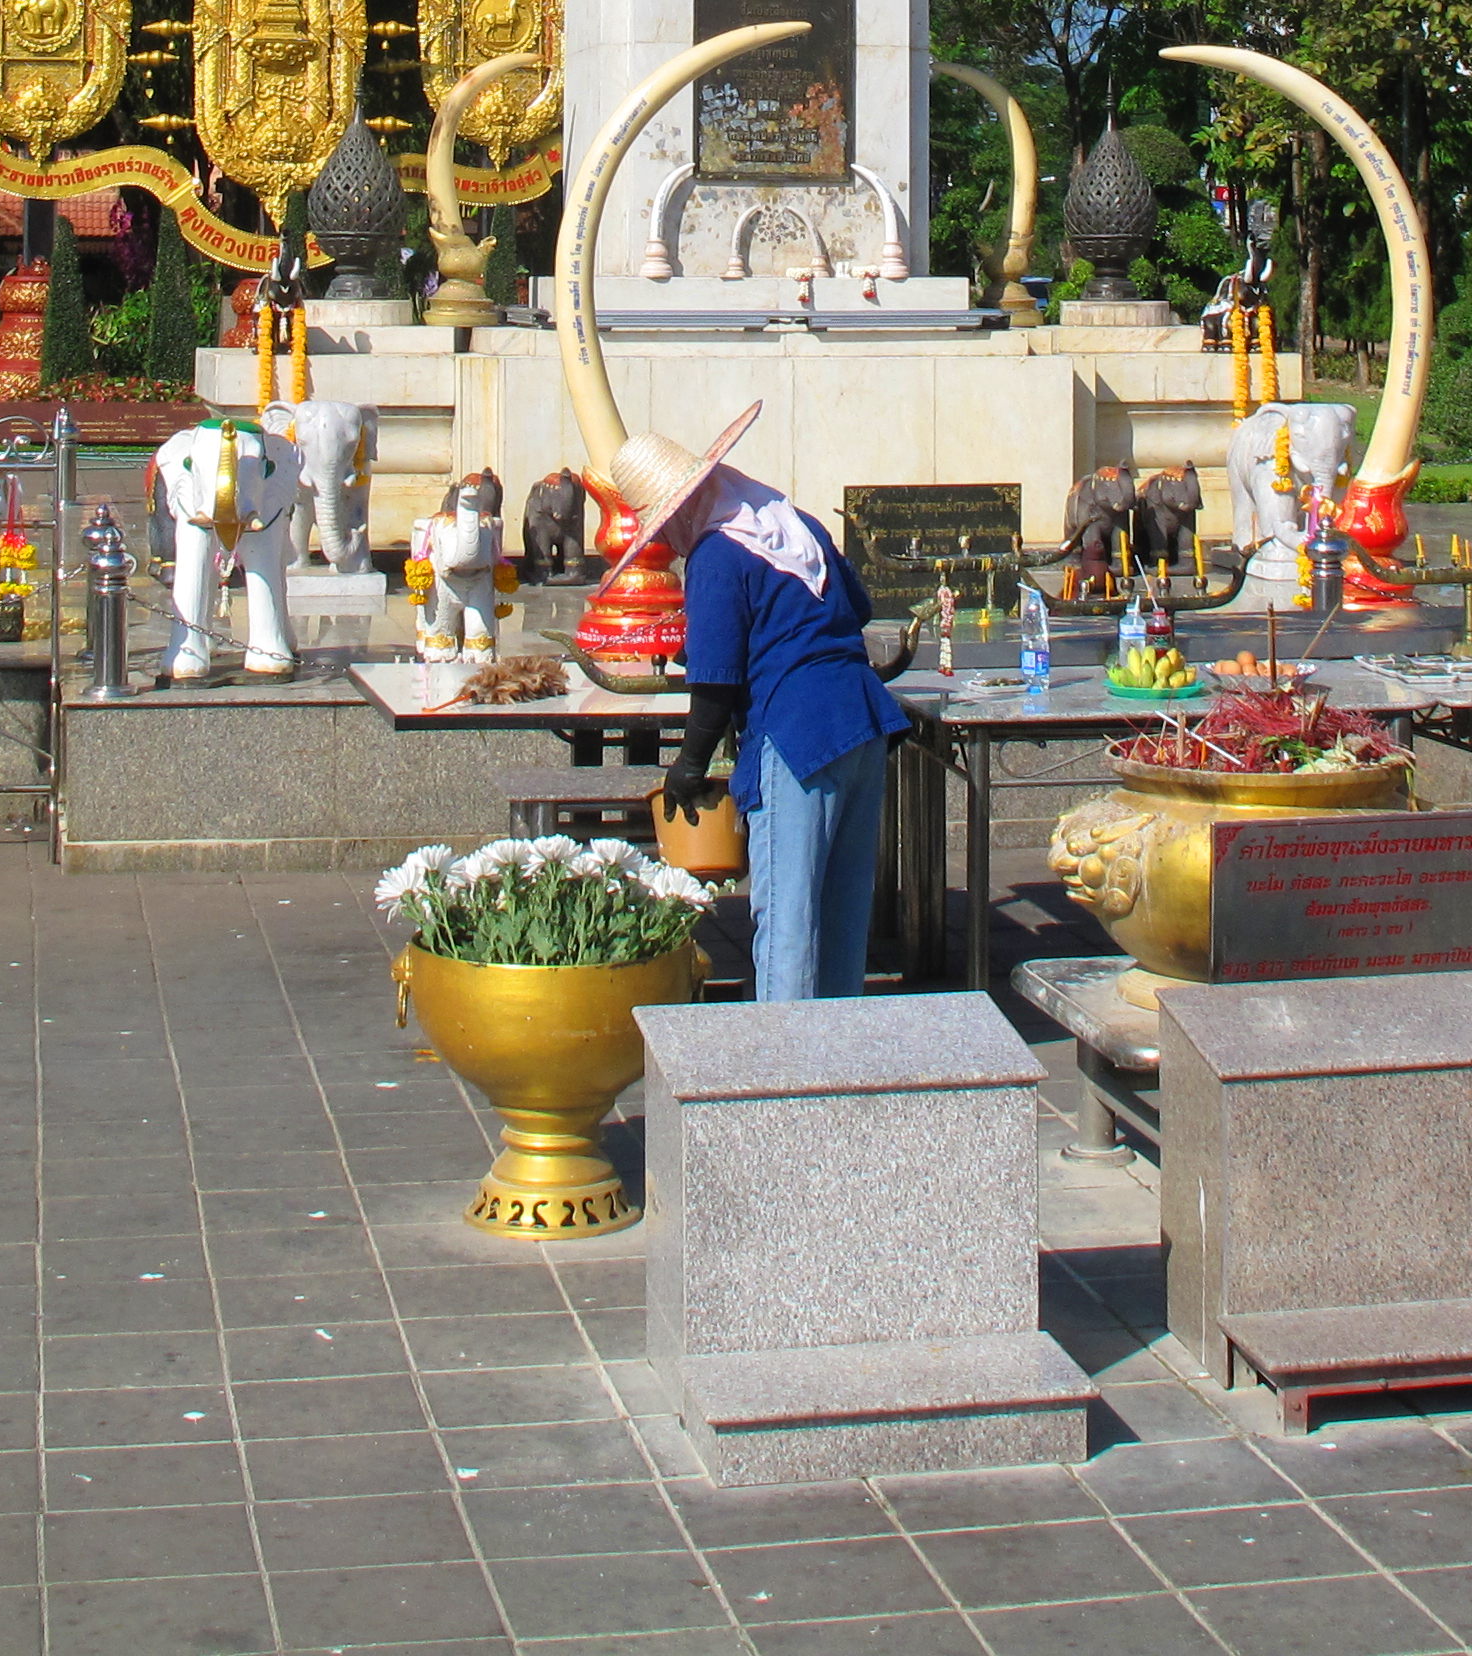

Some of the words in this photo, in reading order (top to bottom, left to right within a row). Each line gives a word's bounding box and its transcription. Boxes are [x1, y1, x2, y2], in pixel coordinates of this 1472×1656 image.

[180, 206, 281, 262] ตุงหลวงเฉล
[1247, 875, 1285, 893] นะโม
[1290, 874, 1332, 891] ตัสสะ
